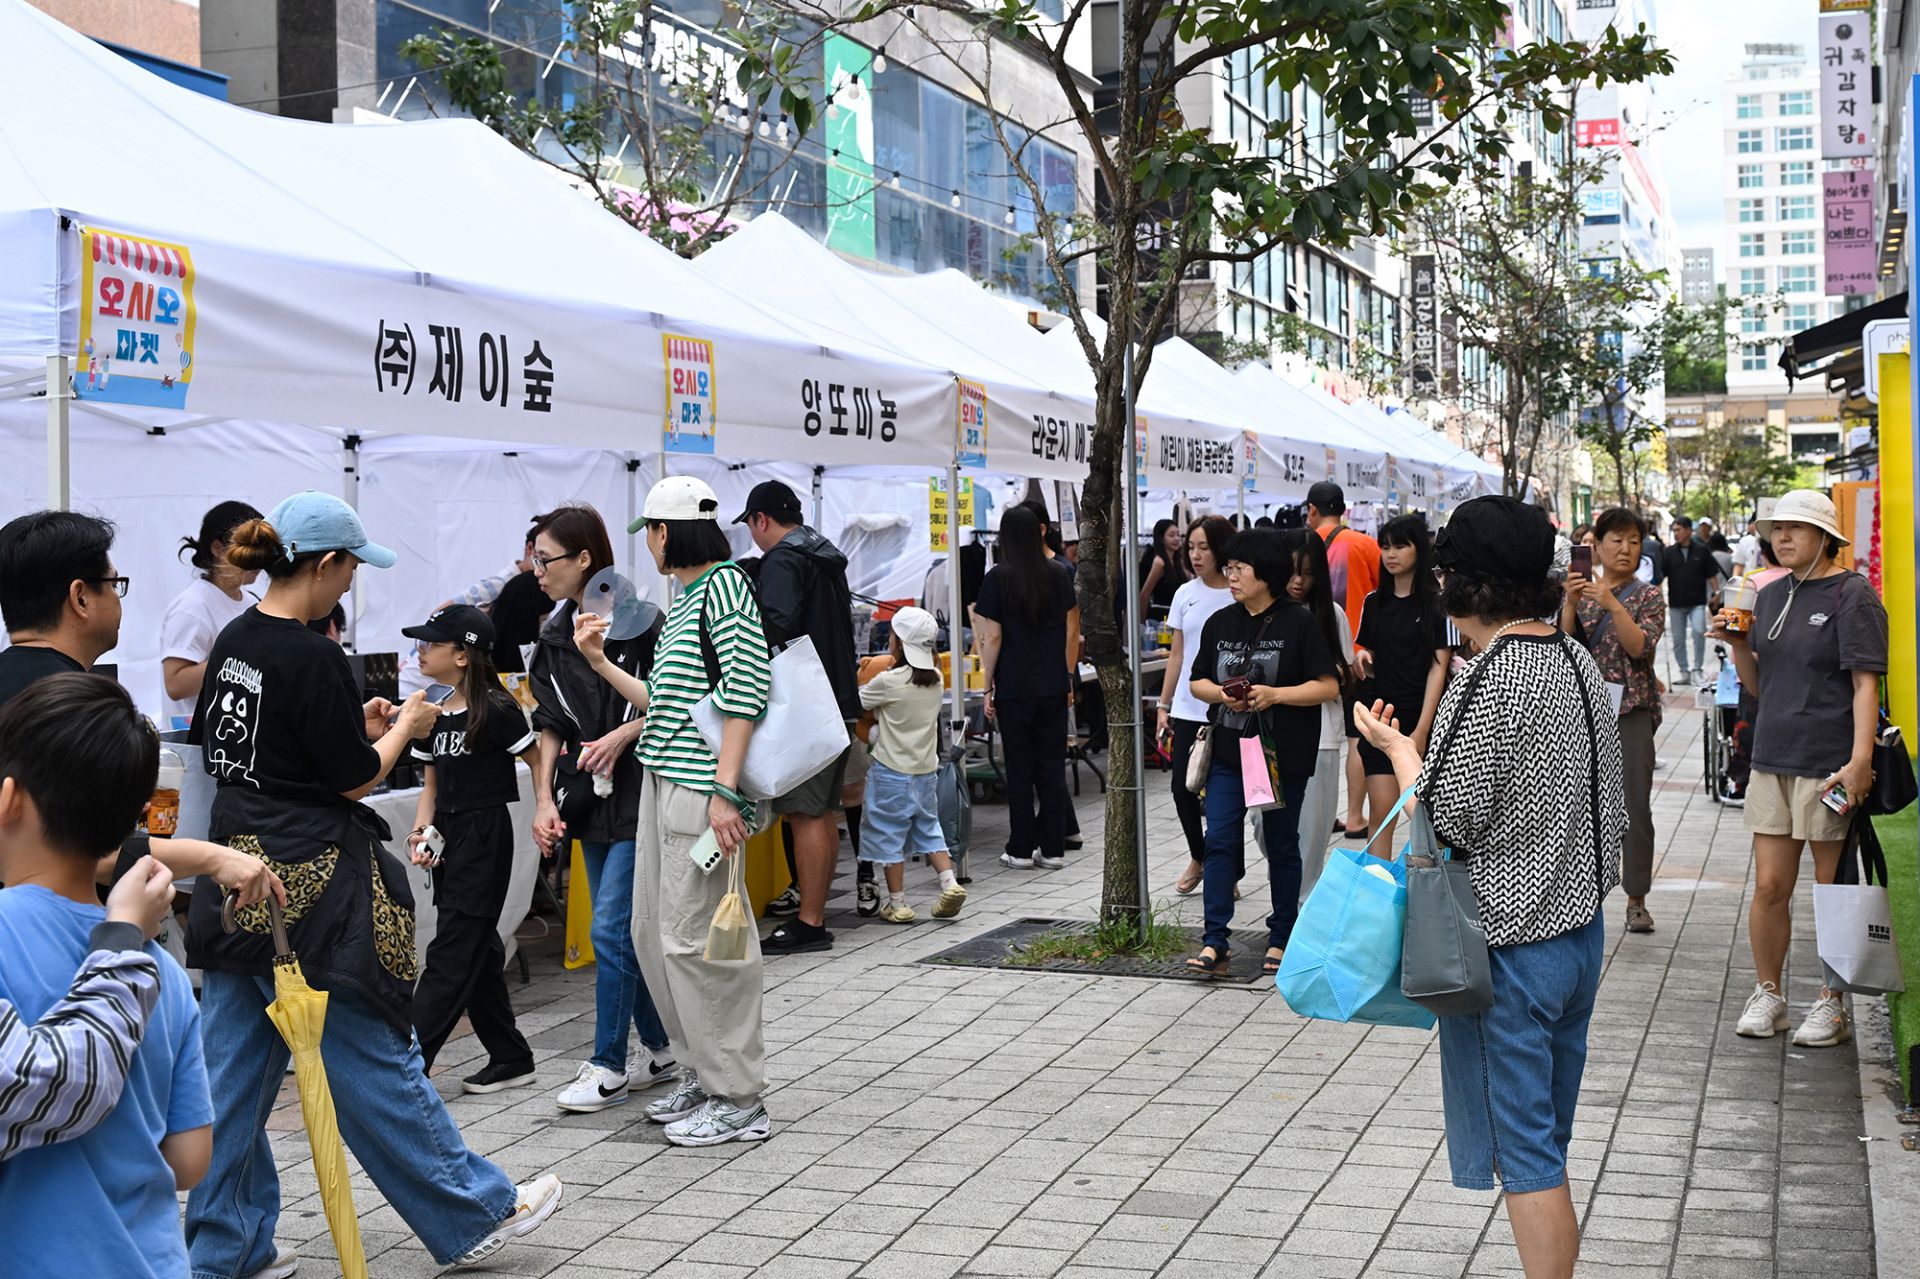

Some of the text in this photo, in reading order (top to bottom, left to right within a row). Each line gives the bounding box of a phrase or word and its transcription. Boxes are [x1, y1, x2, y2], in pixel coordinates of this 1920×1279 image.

[1837, 71, 1857, 144] 감자탕
[1828, 205, 1855, 221] 나는
[1828, 226, 1870, 240] 예쁘다
[99, 276, 181, 326] 오시오
[115, 328, 160, 365] 마켓
[673, 367, 710, 398] 오시오
[681, 401, 702, 426] 마켓
[801, 378, 899, 443] 앙또미뇽
[962, 402, 984, 426] 오시오
[1032, 414, 1071, 463] 라운지
[1160, 435, 1185, 472] 어린이
[1187, 436, 1202, 473] 체험
[1243, 639, 1285, 652] AIENNE
